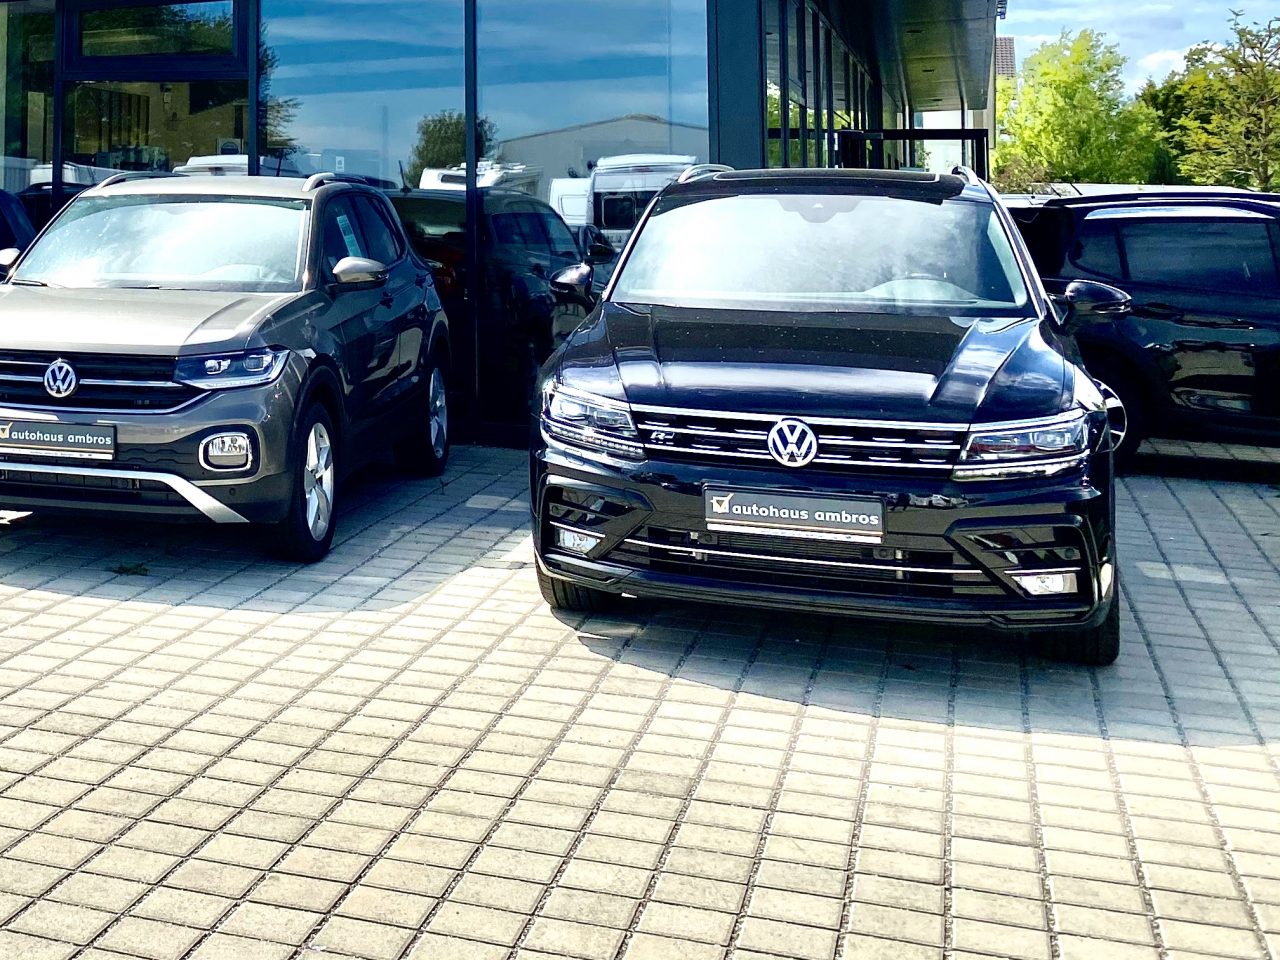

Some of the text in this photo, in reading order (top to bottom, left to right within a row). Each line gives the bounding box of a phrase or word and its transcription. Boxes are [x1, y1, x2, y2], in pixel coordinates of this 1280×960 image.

[11, 431, 112, 444] autohaus ambros
[732, 503, 879, 525] autohaus ambros
